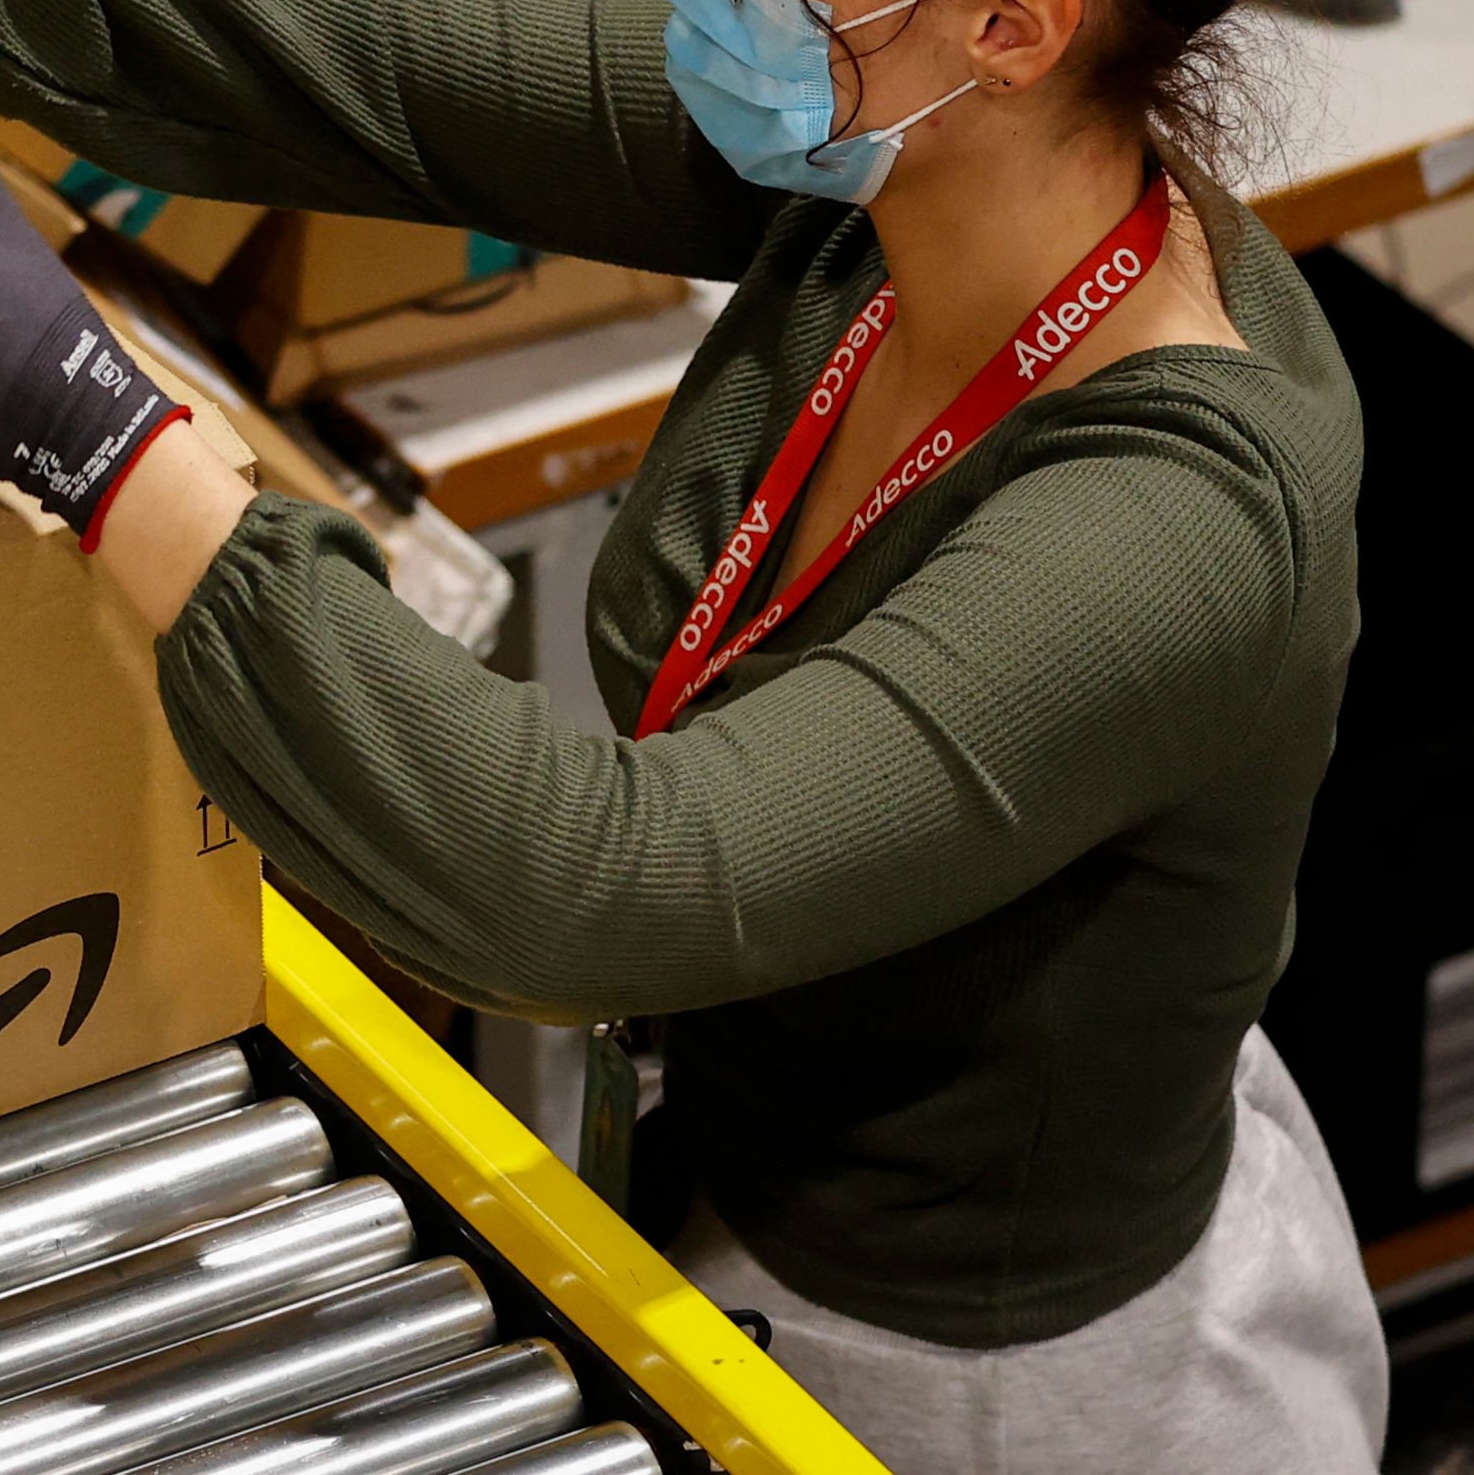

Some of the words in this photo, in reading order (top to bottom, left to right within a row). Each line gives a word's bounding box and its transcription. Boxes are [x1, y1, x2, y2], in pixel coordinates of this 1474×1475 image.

[1012, 247, 1142, 381] Adecco
[845, 429, 954, 550] Adecco
[679, 500, 770, 652] Adecco
